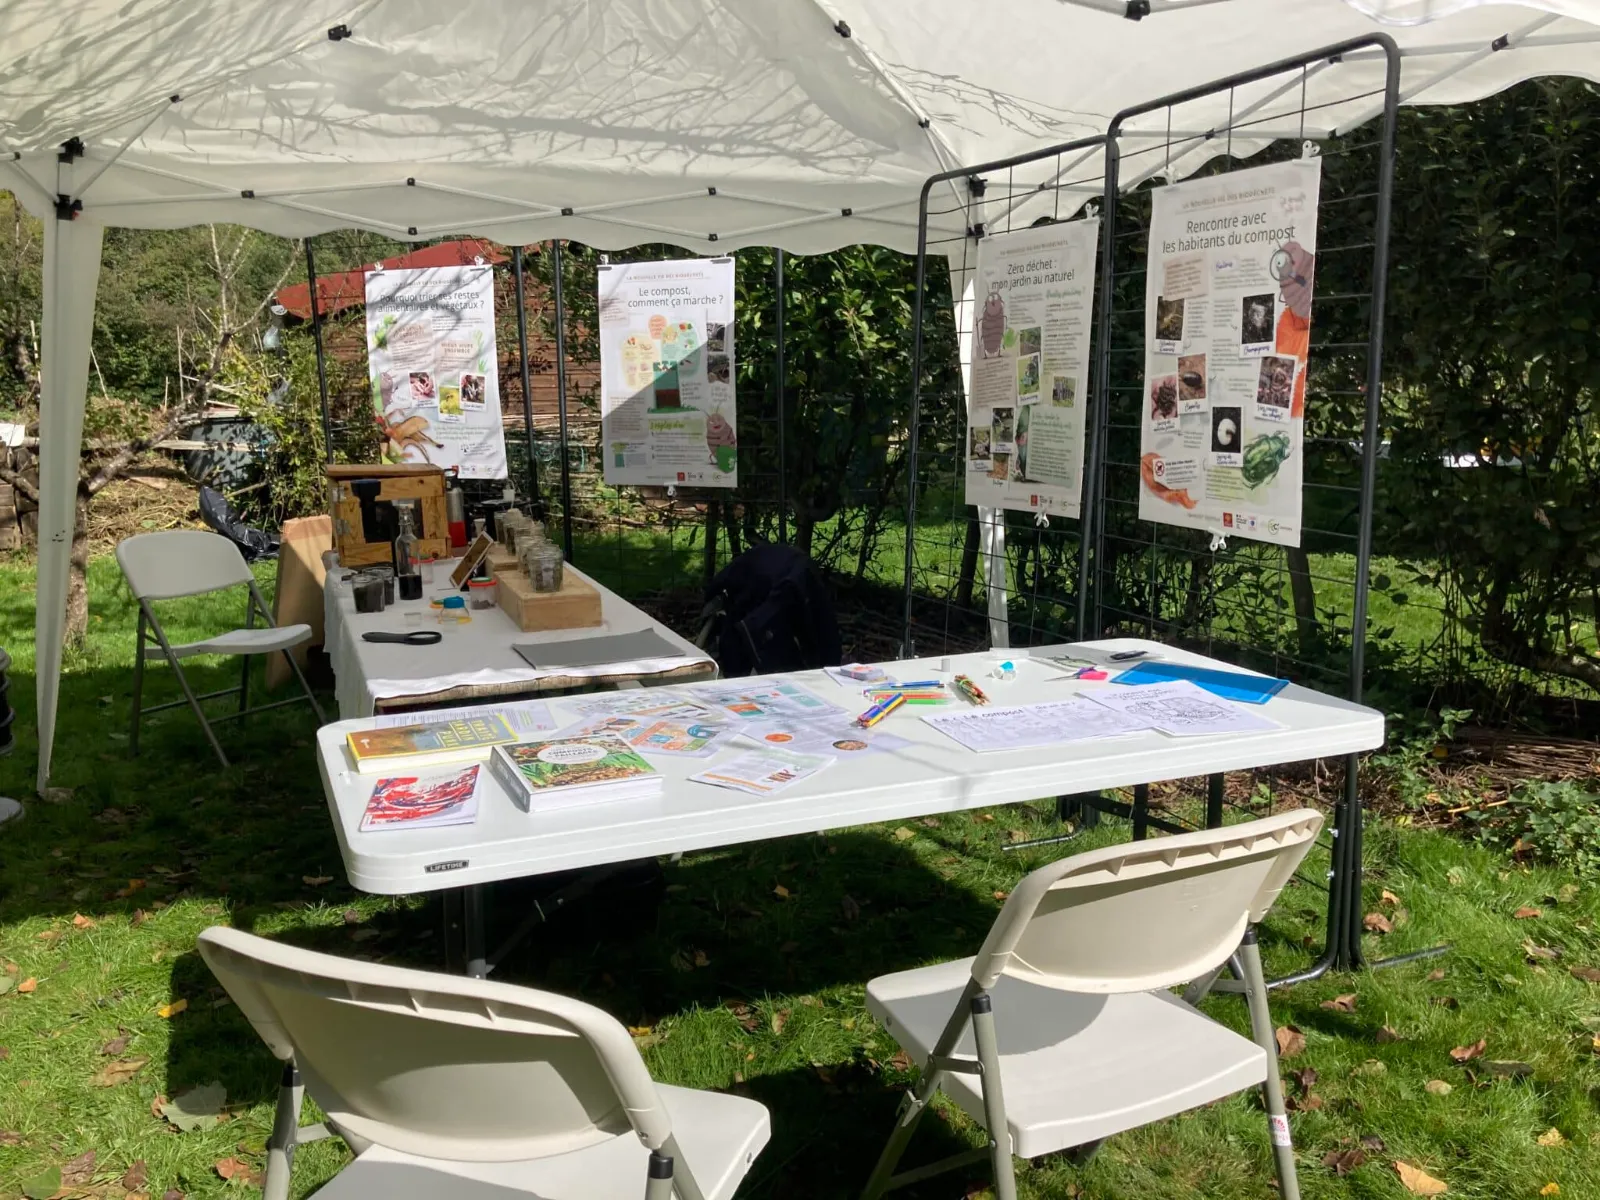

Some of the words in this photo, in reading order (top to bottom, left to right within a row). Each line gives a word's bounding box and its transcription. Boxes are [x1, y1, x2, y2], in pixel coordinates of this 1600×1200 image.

[1186, 216, 1239, 234] Rencontre
[1241, 211, 1267, 226] avec
[1162, 240, 1176, 254] les
[1178, 231, 1226, 252] habitants
[1228, 231, 1242, 246] du
[1244, 225, 1296, 244] compost
[1007, 263, 1025, 275] Zéro
[1026, 259, 1053, 273] déchet
[991, 279, 1009, 290] mon
[1008, 275, 1032, 291] jardin
[1032, 275, 1043, 285] au
[1044, 268, 1075, 283] naturel
[380, 293, 418, 303] Pourquoi
[454, 291, 480, 300] restes
[639, 287, 649, 297] Le
[651, 286, 691, 298] compost,
[379, 303, 429, 313] alimentaires
[431, 302, 439, 311] et
[441, 302, 478, 313] végétaux
[479, 300, 485, 311] ?
[628, 298, 668, 308] comment
[671, 297, 681, 308] ça
[683, 294, 717, 306] marche
[719, 294, 724, 305] ?
[982, 708, 1023, 718] compost
[430, 861, 464, 872] LIFETIME
